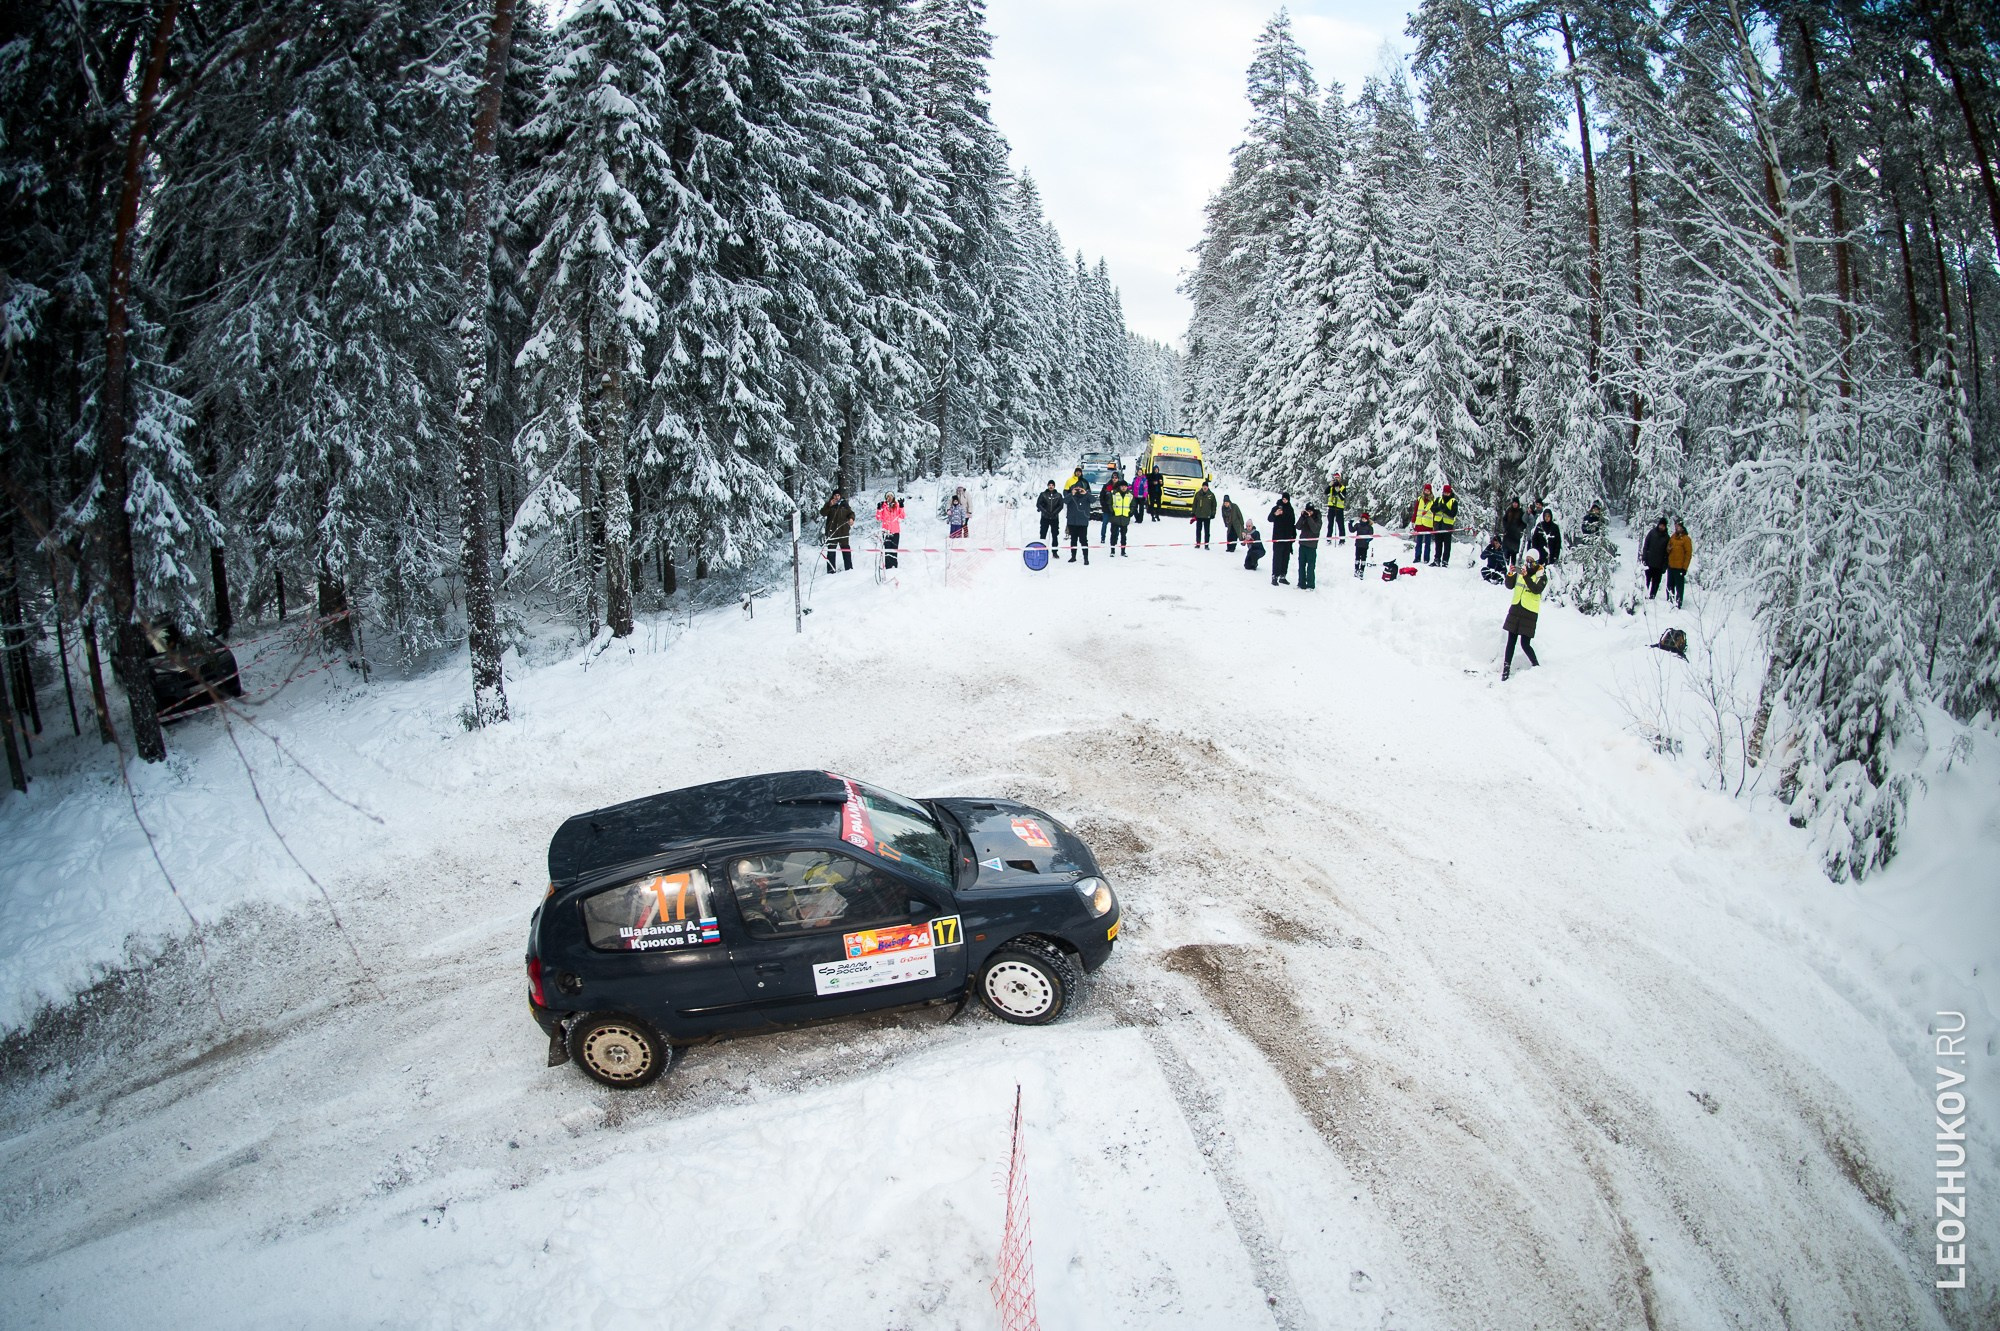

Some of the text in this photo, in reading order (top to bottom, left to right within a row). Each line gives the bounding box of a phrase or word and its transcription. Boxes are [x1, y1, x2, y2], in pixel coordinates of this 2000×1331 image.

[878, 841, 902, 861] 17
[650, 874, 690, 922] 17
[620, 921, 700, 937] Шаванов А.
[934, 918, 957, 944] 17
[631, 933, 702, 950] Крюков В.
[908, 933, 929, 947] 24
